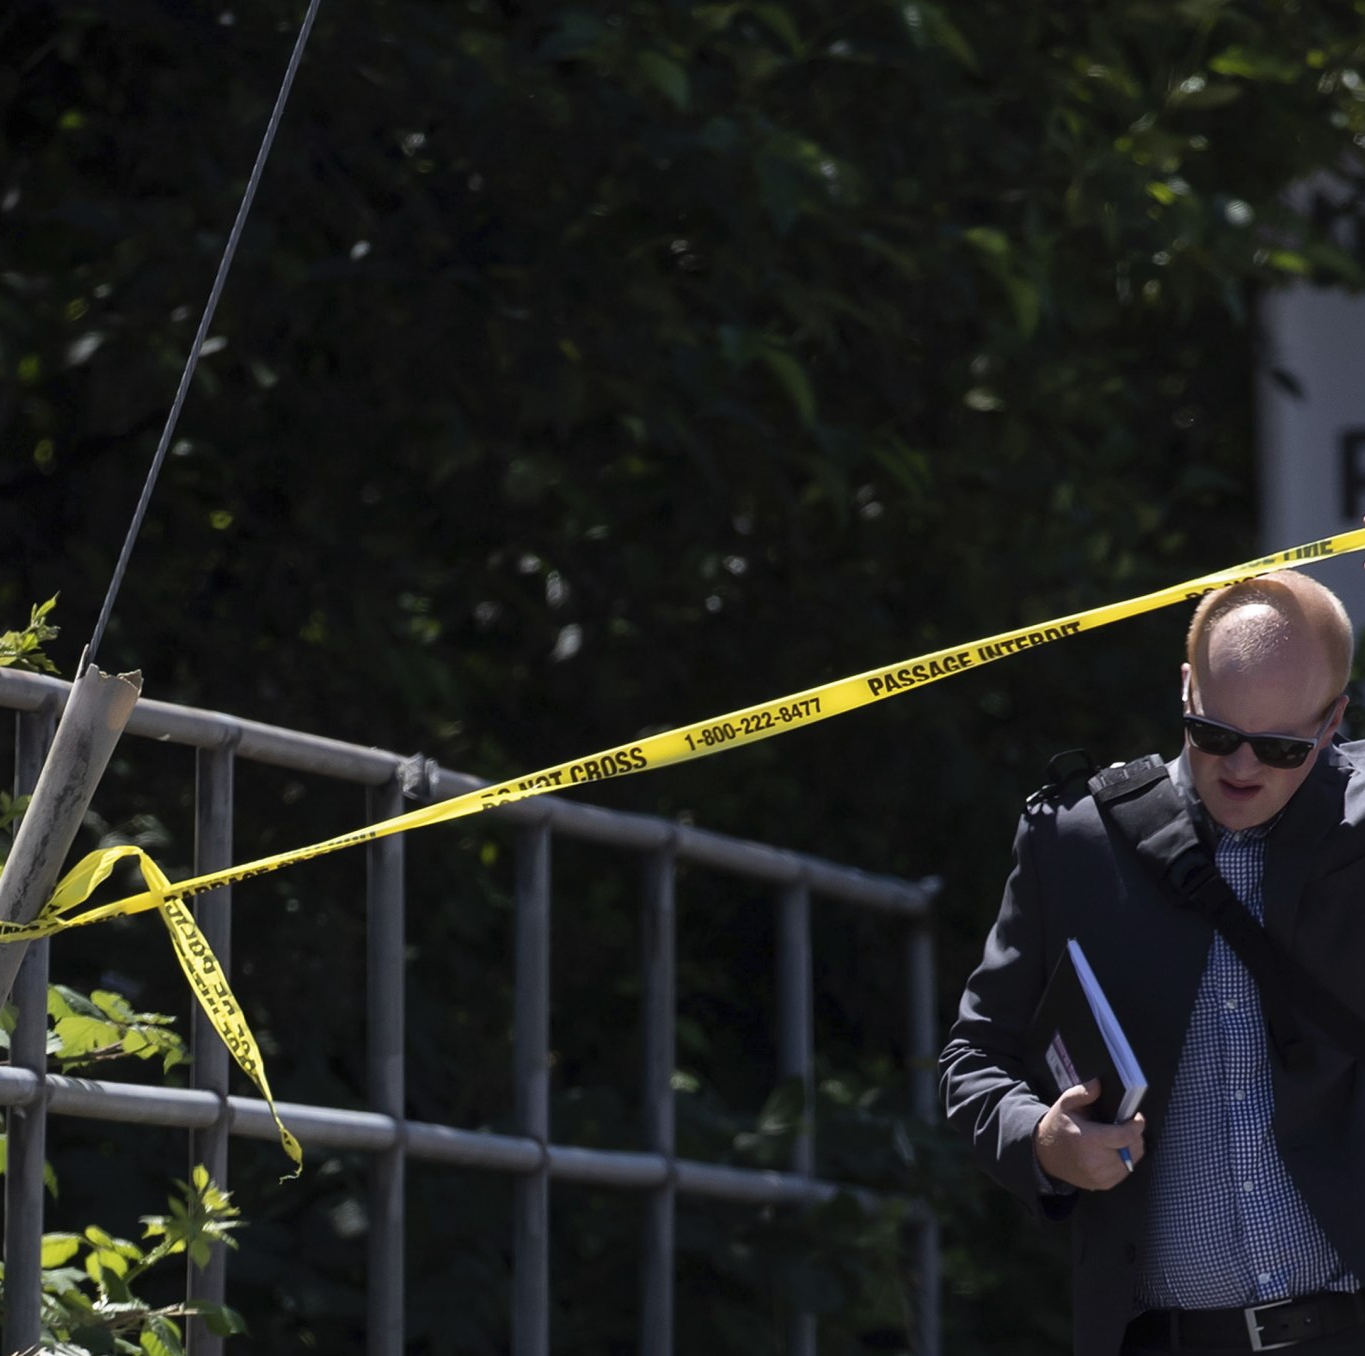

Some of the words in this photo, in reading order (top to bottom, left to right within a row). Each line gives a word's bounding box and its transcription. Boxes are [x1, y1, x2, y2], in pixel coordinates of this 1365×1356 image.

[867, 651, 974, 697] PASSAGE
[976, 620, 1082, 663] INTERDIT
[683, 696, 824, 754] 1-800-222-8477
[569, 746, 648, 784] CROSS
